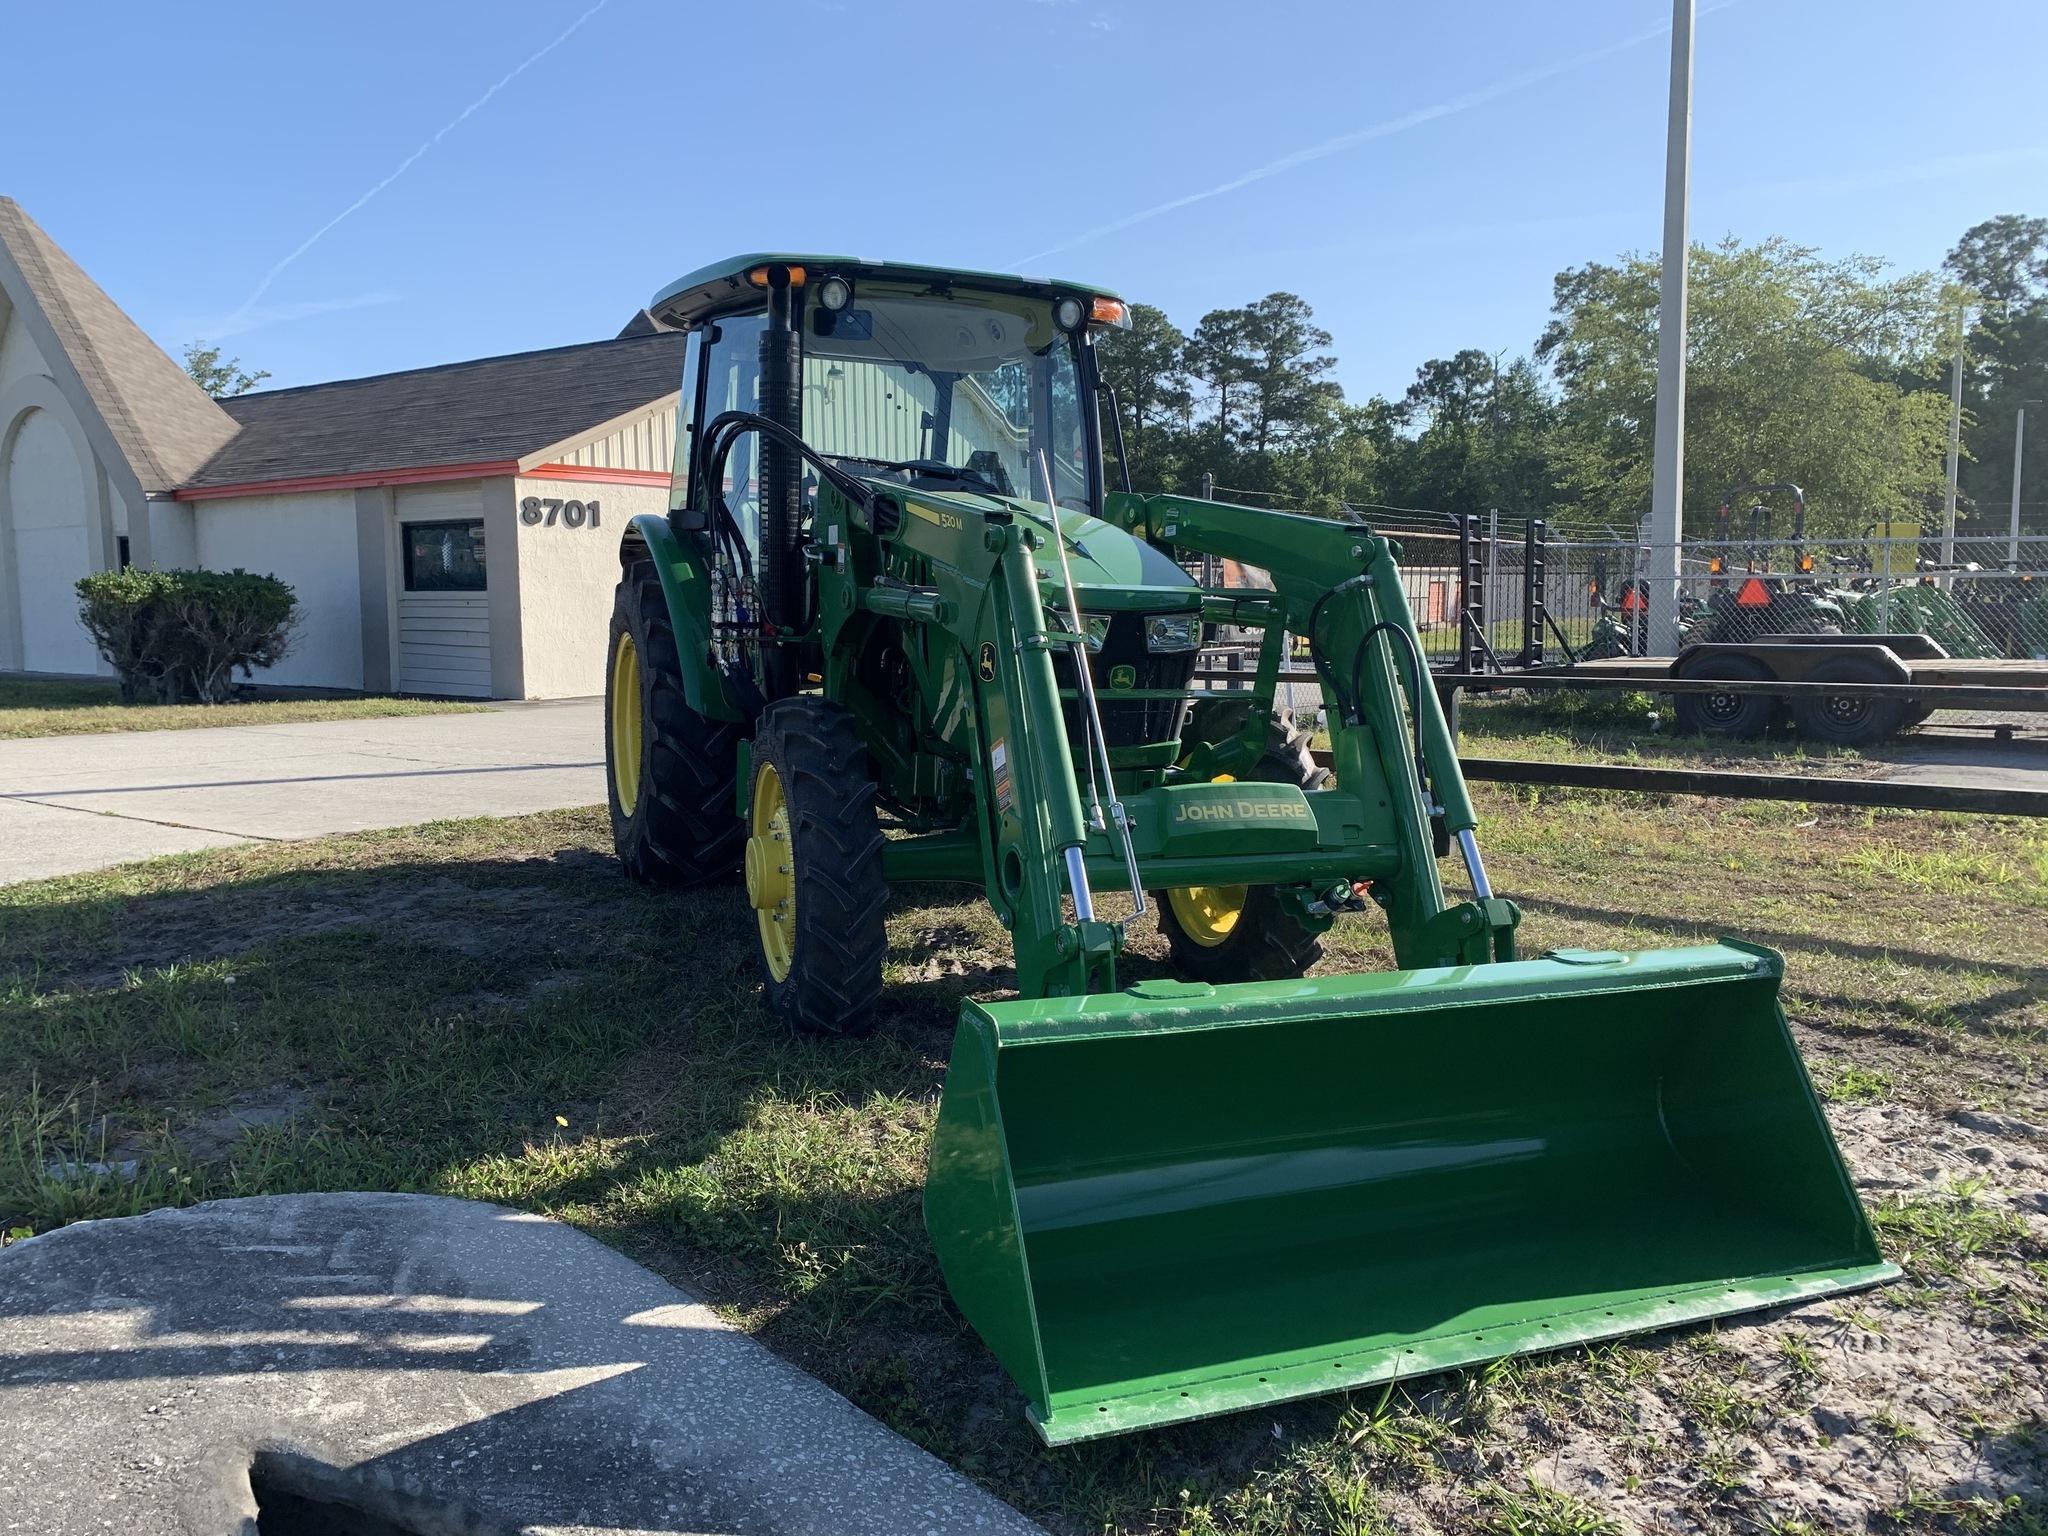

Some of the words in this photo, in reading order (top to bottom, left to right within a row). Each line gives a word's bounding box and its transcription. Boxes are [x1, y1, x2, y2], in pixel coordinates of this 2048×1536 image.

[520, 496, 601, 528] 8701
[1175, 804, 1234, 821] JOHN
[1238, 801, 1308, 818] DEERE
